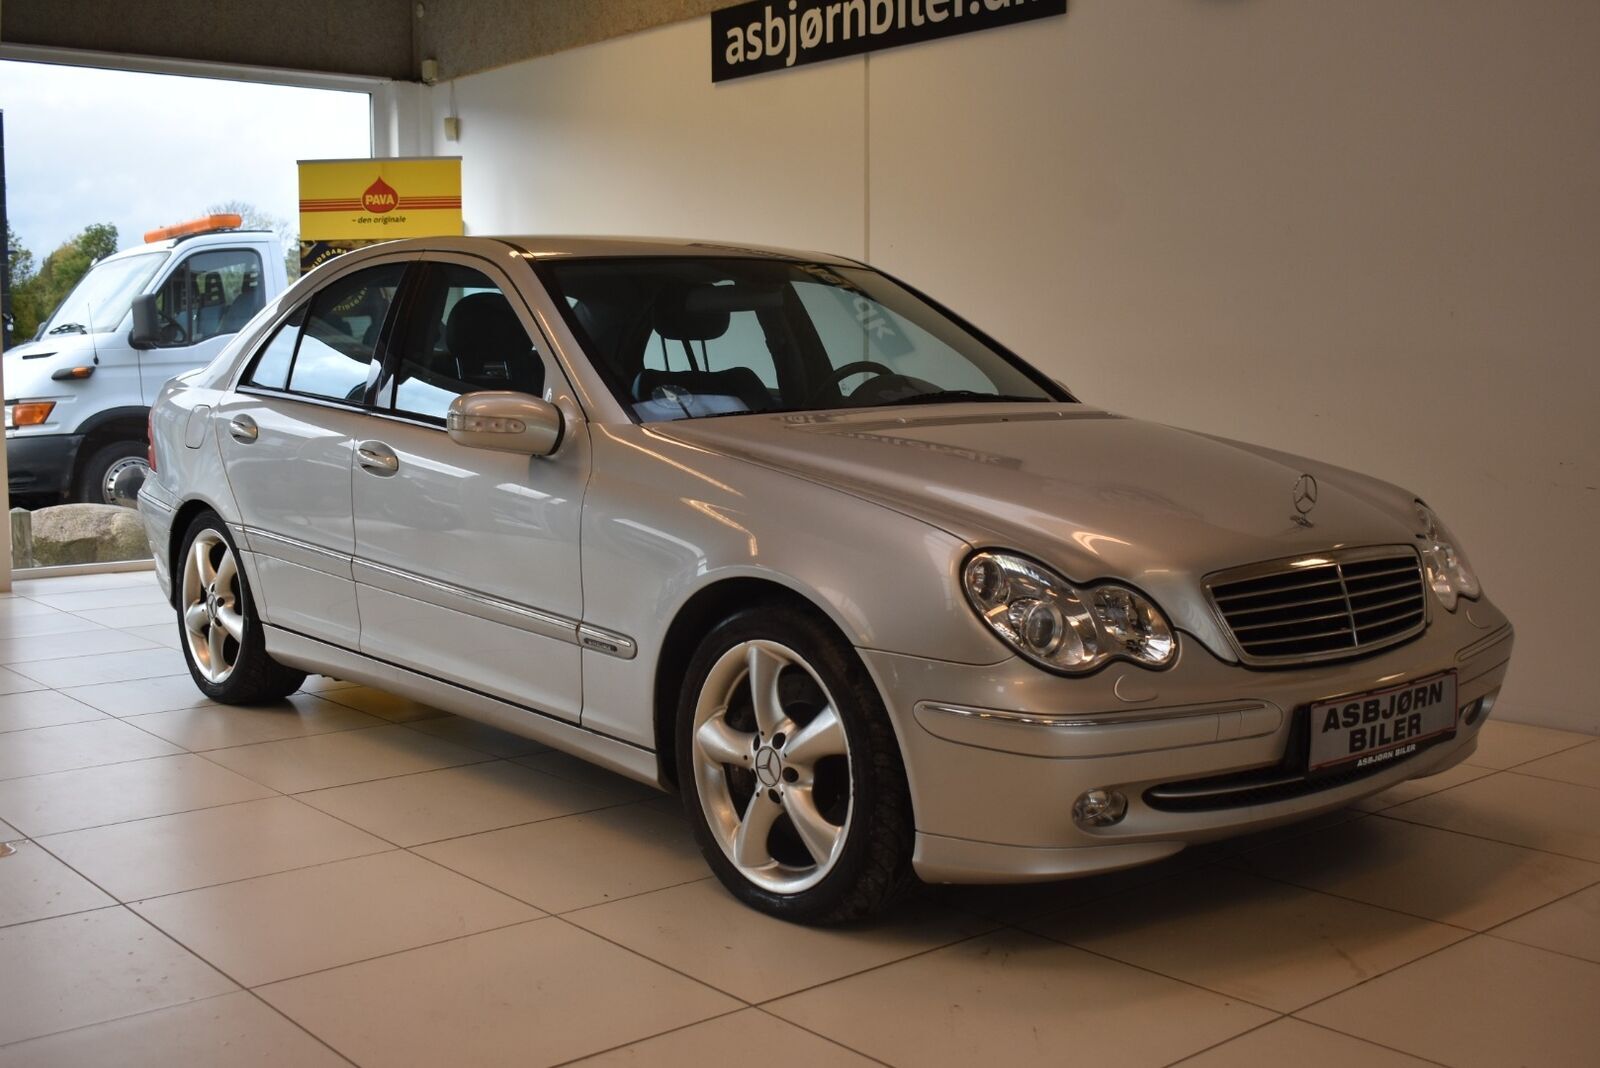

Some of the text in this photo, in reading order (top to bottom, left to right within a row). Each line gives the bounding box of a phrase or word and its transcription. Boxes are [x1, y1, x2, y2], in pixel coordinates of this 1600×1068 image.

[365, 194, 395, 205] PAVA
[358, 216, 372, 224] den
[373, 216, 406, 225] originale
[1321, 680, 1444, 734] ASBJØRN
[1349, 713, 1422, 753] BILER
[1395, 744, 1416, 756] BILER
